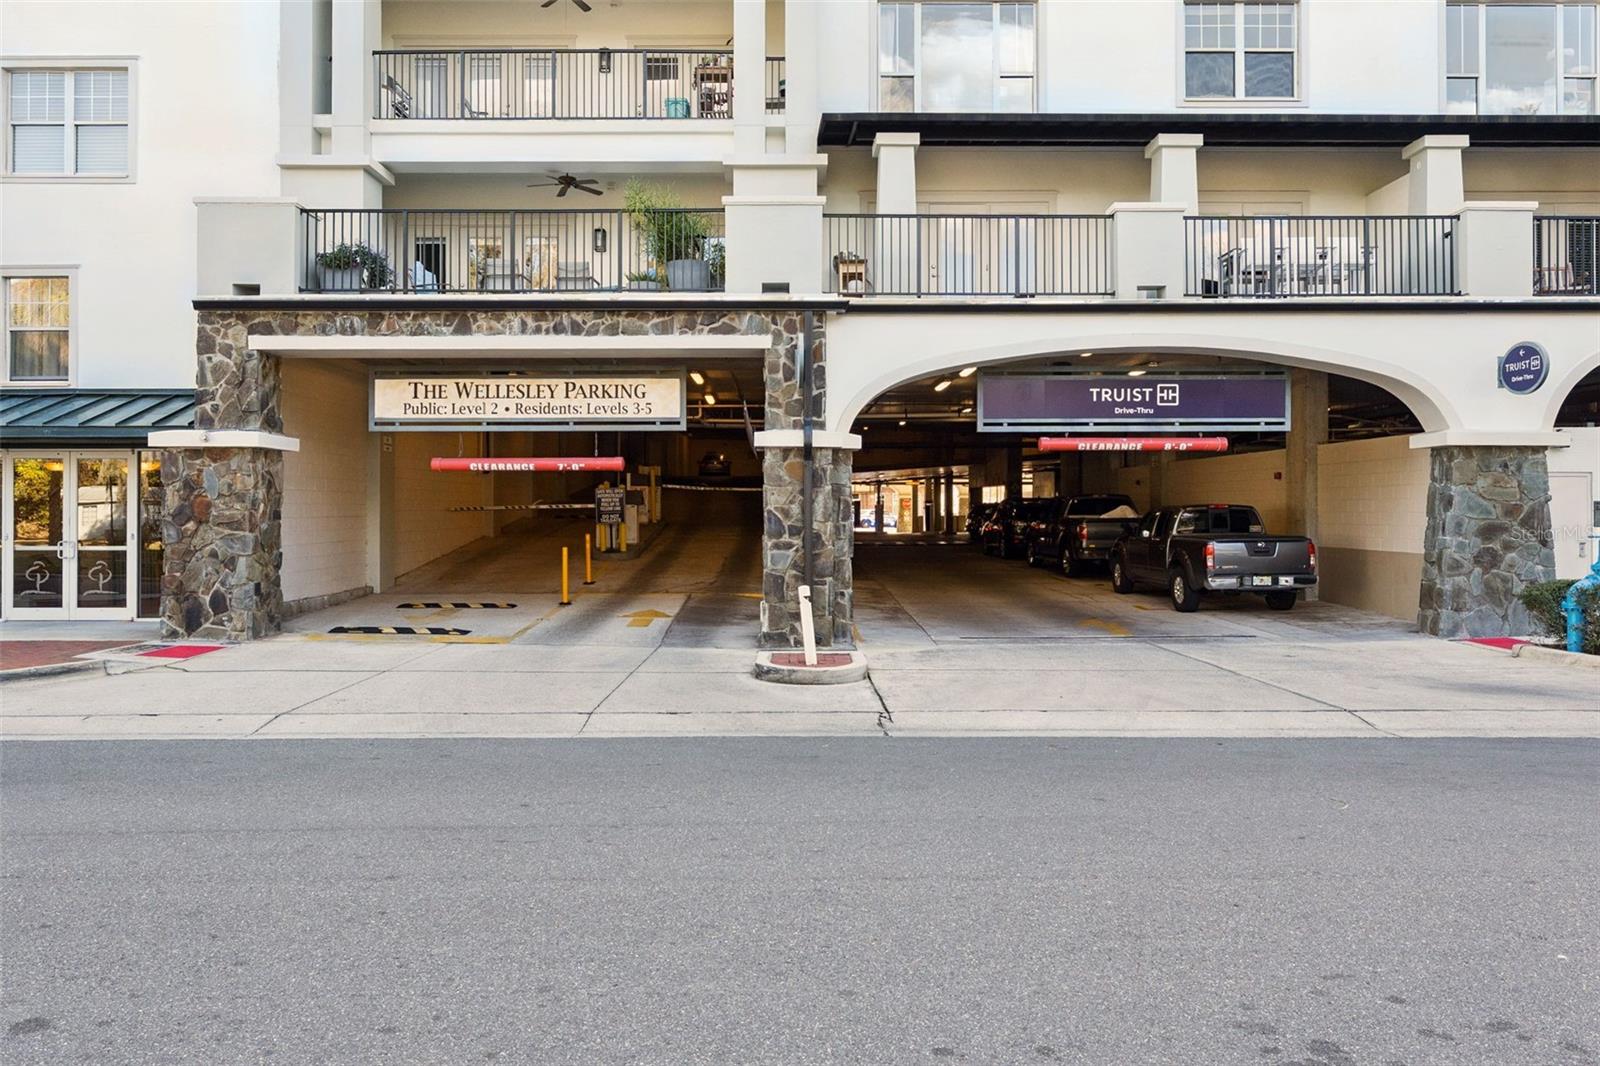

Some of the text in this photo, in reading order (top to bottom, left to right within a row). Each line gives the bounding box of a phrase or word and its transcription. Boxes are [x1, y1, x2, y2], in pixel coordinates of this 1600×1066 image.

[1505, 360, 1530, 372] TRUIST
[1511, 374, 1534, 383] Drive-Thru
[408, 381, 647, 400] THE WELLESLEY PARKING
[1089, 388, 1153, 402] TRUIST
[403, 402, 653, 415] Public: Level 2 Residents: Levels 3-5
[1078, 442, 1143, 451] CLEARANCE
[469, 463, 536, 471] CLEARANCE
